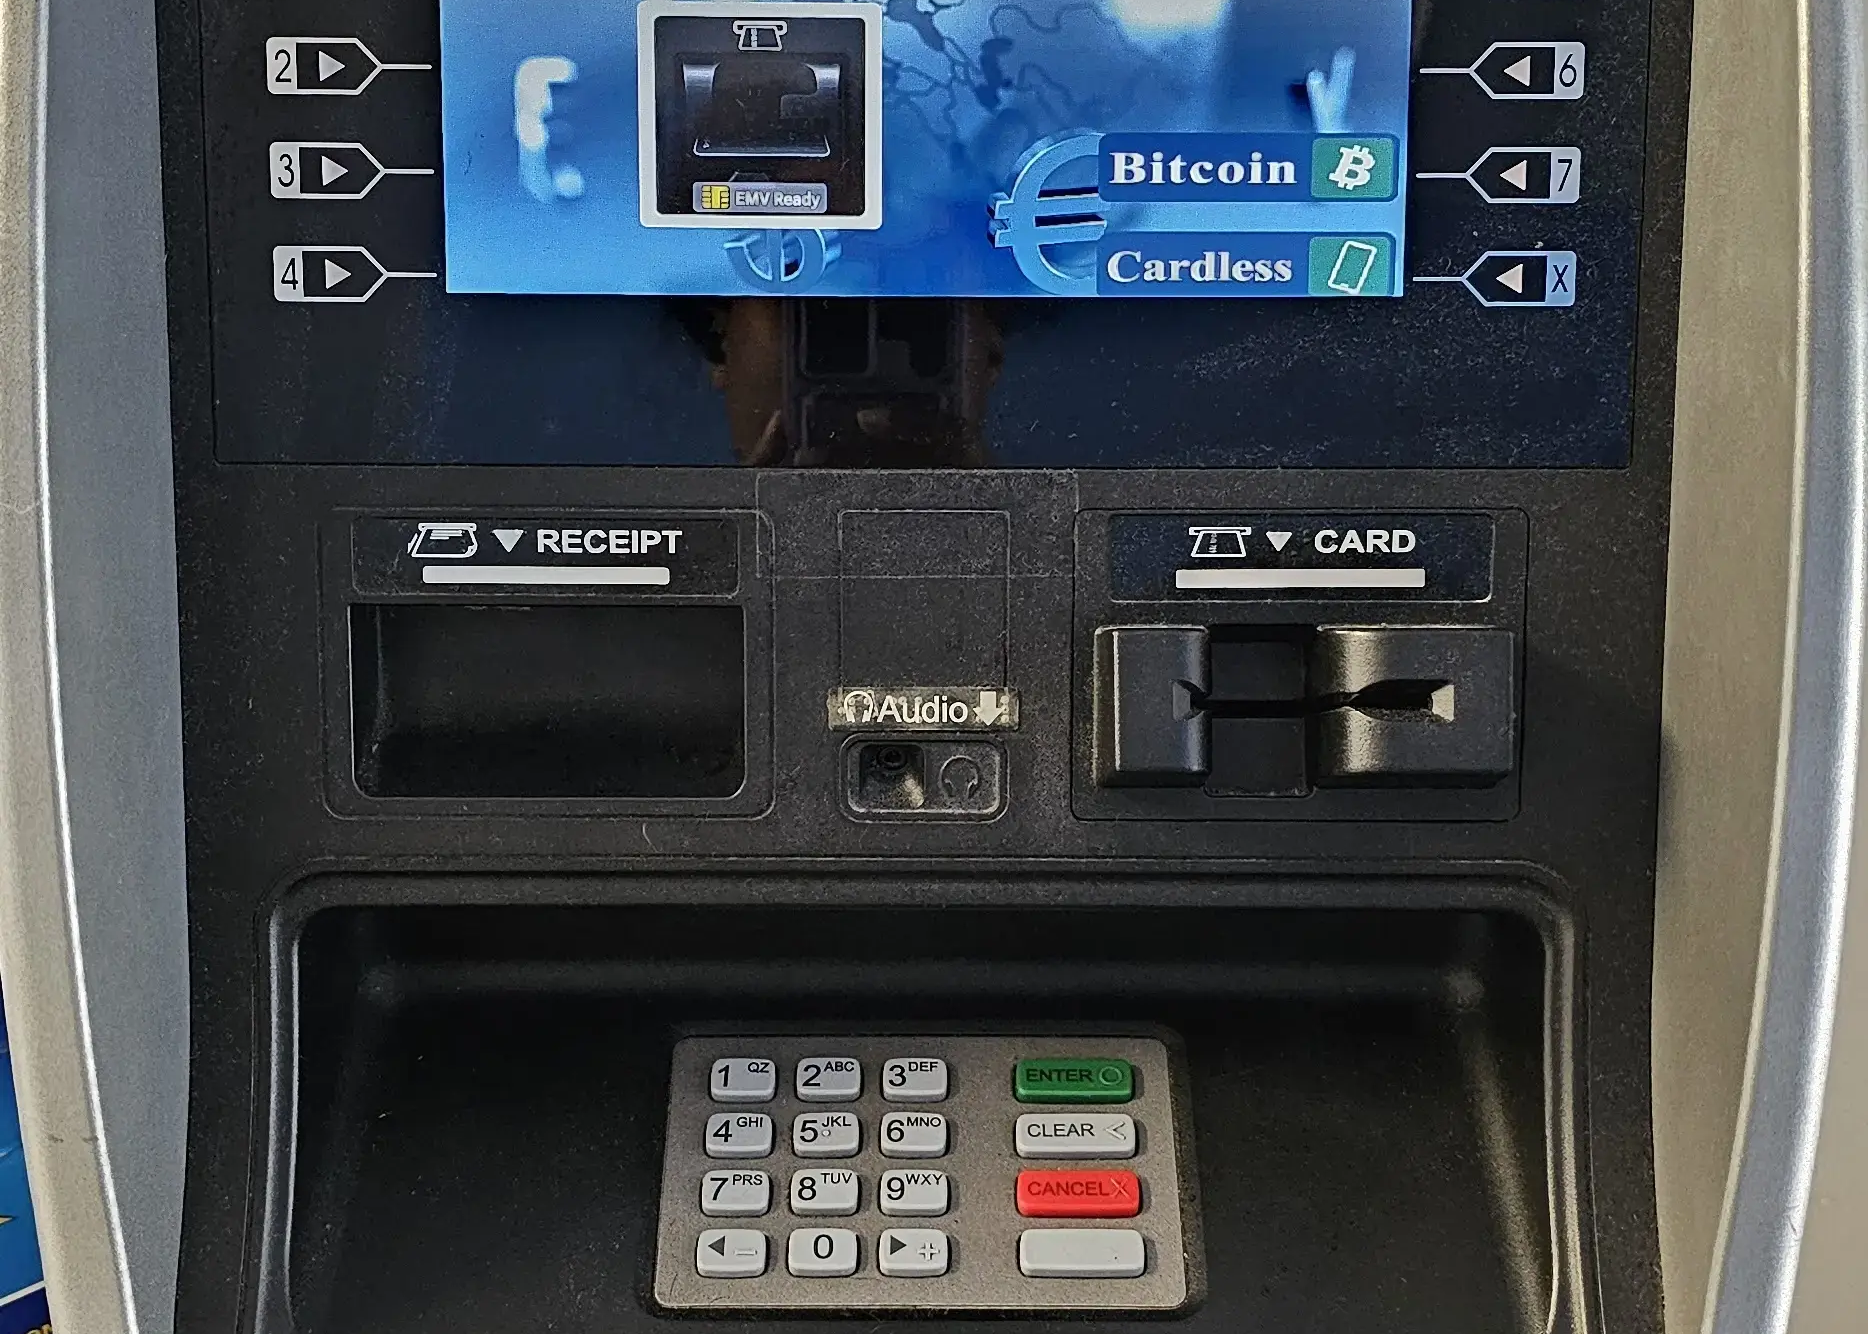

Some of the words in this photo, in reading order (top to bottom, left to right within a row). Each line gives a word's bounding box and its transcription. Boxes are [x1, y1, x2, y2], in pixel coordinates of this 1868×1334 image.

[274, 49, 292, 83] 2
[1558, 54, 1578, 88] 6
[278, 153, 295, 187] 3
[1109, 151, 1298, 186] Bitcoin
[1557, 158, 1574, 192] 7
[735, 189, 769, 208] EMV
[772, 190, 820, 212] Ready
[281, 258, 298, 290] 4
[1106, 250, 1293, 283] Cardless
[1551, 265, 1569, 293] X
[537, 529, 683, 555] RECEIPT
[1314, 530, 1416, 553] CARD
[877, 695, 968, 723] Audio
[717, 1066, 730, 1087] 1
[747, 1062, 770, 1074] QZ
[802, 1065, 821, 1087] 2
[823, 1061, 855, 1072] ABC
[888, 1064, 907, 1087] 3
[908, 1061, 939, 1072] DEF
[1025, 1069, 1093, 1083] ENTER
[713, 1120, 733, 1142] 4
[736, 1116, 764, 1129] GHI
[799, 1119, 818, 1142] 5
[822, 1116, 852, 1129] JKL
[886, 1119, 905, 1142] 6
[906, 1116, 942, 1128] MNO
[1027, 1123, 1095, 1138] CLEAR
[710, 1178, 729, 1201] 7
[732, 1174, 763, 1187] PRS
[797, 1177, 817, 1201] 8
[822, 1173, 853, 1185] TUV
[886, 1177, 905, 1201] 9
[906, 1173, 943, 1186] WXY
[1027, 1181, 1110, 1197] CANCEL
[813, 1235, 834, 1259] 0
